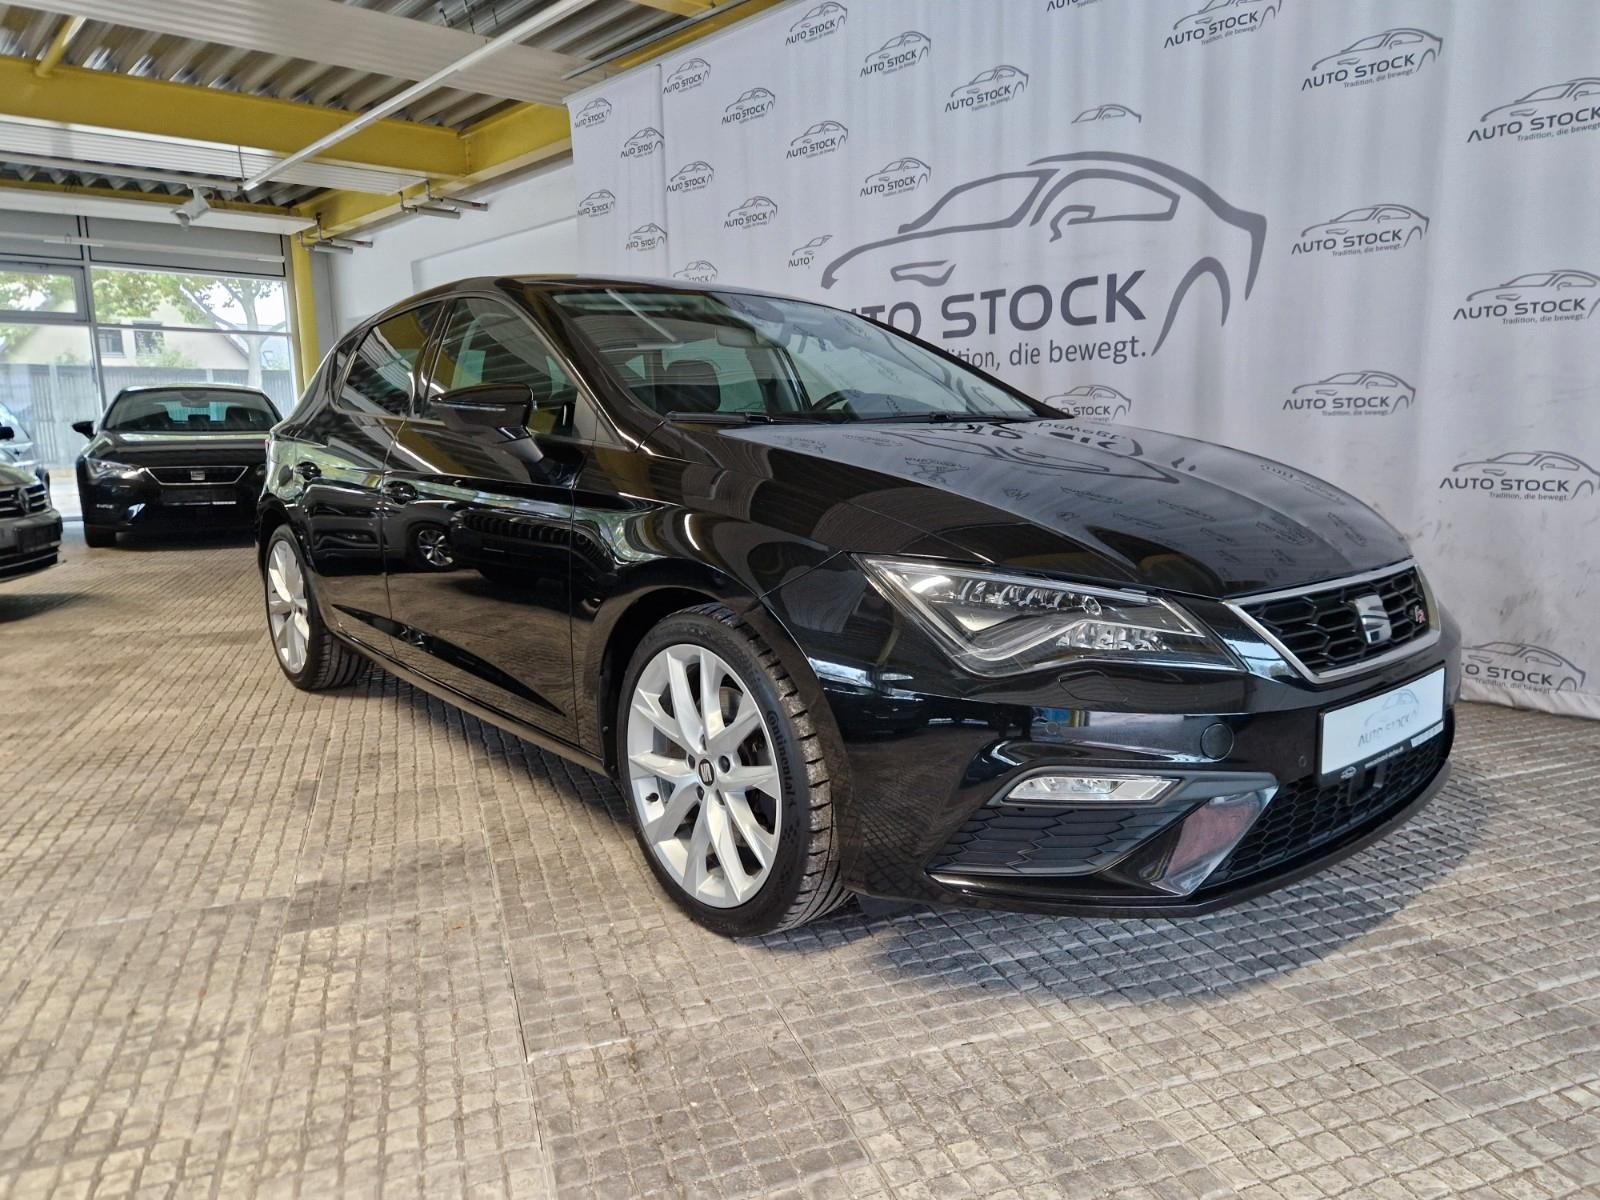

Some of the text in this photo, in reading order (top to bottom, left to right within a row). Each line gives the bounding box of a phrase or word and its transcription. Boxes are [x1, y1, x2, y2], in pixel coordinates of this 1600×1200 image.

[1047, 0, 1079, 12] AU
[785, 31, 807, 46] AUTO
[809, 19, 835, 34] STOCK
[1163, 10, 1258, 48] AUTO STOCK
[859, 62, 885, 77] AUTO
[887, 49, 917, 68] STOCK
[1301, 53, 1415, 91] AUTO STOCK
[663, 82, 680, 94] AUTO
[681, 73, 702, 87] STOCK
[945, 97, 974, 112] AUTO
[977, 85, 1011, 104] STOCK
[721, 112, 741, 125] AUTO
[742, 103, 765, 118] STOCK
[1467, 106, 1600, 143] AUTO STOCK
[786, 146, 807, 159] AUTO
[809, 137, 836, 152] STOCK
[666, 183, 683, 192] AUTO
[684, 176, 706, 188] STOCK
[859, 184, 885, 198] AUTO
[887, 175, 916, 191] STOCK
[724, 218, 744, 228] AUTO
[745, 212, 768, 224] STOCK
[1291, 229, 1402, 255] AUTO STOCK
[788, 256, 810, 268] AUTO
[942, 269, 1146, 339] STOCK
[1453, 297, 1586, 320] AUTO STOCK
[1009, 342, 1040, 366] die
[1049, 335, 1146, 365] bewegt.
[1073, 405, 1111, 416] STOCK
[1282, 396, 1390, 410] AUTO STOCK
[1440, 478, 1569, 492] AUTO STOCK
[1487, 666, 1553, 686] STOCK
